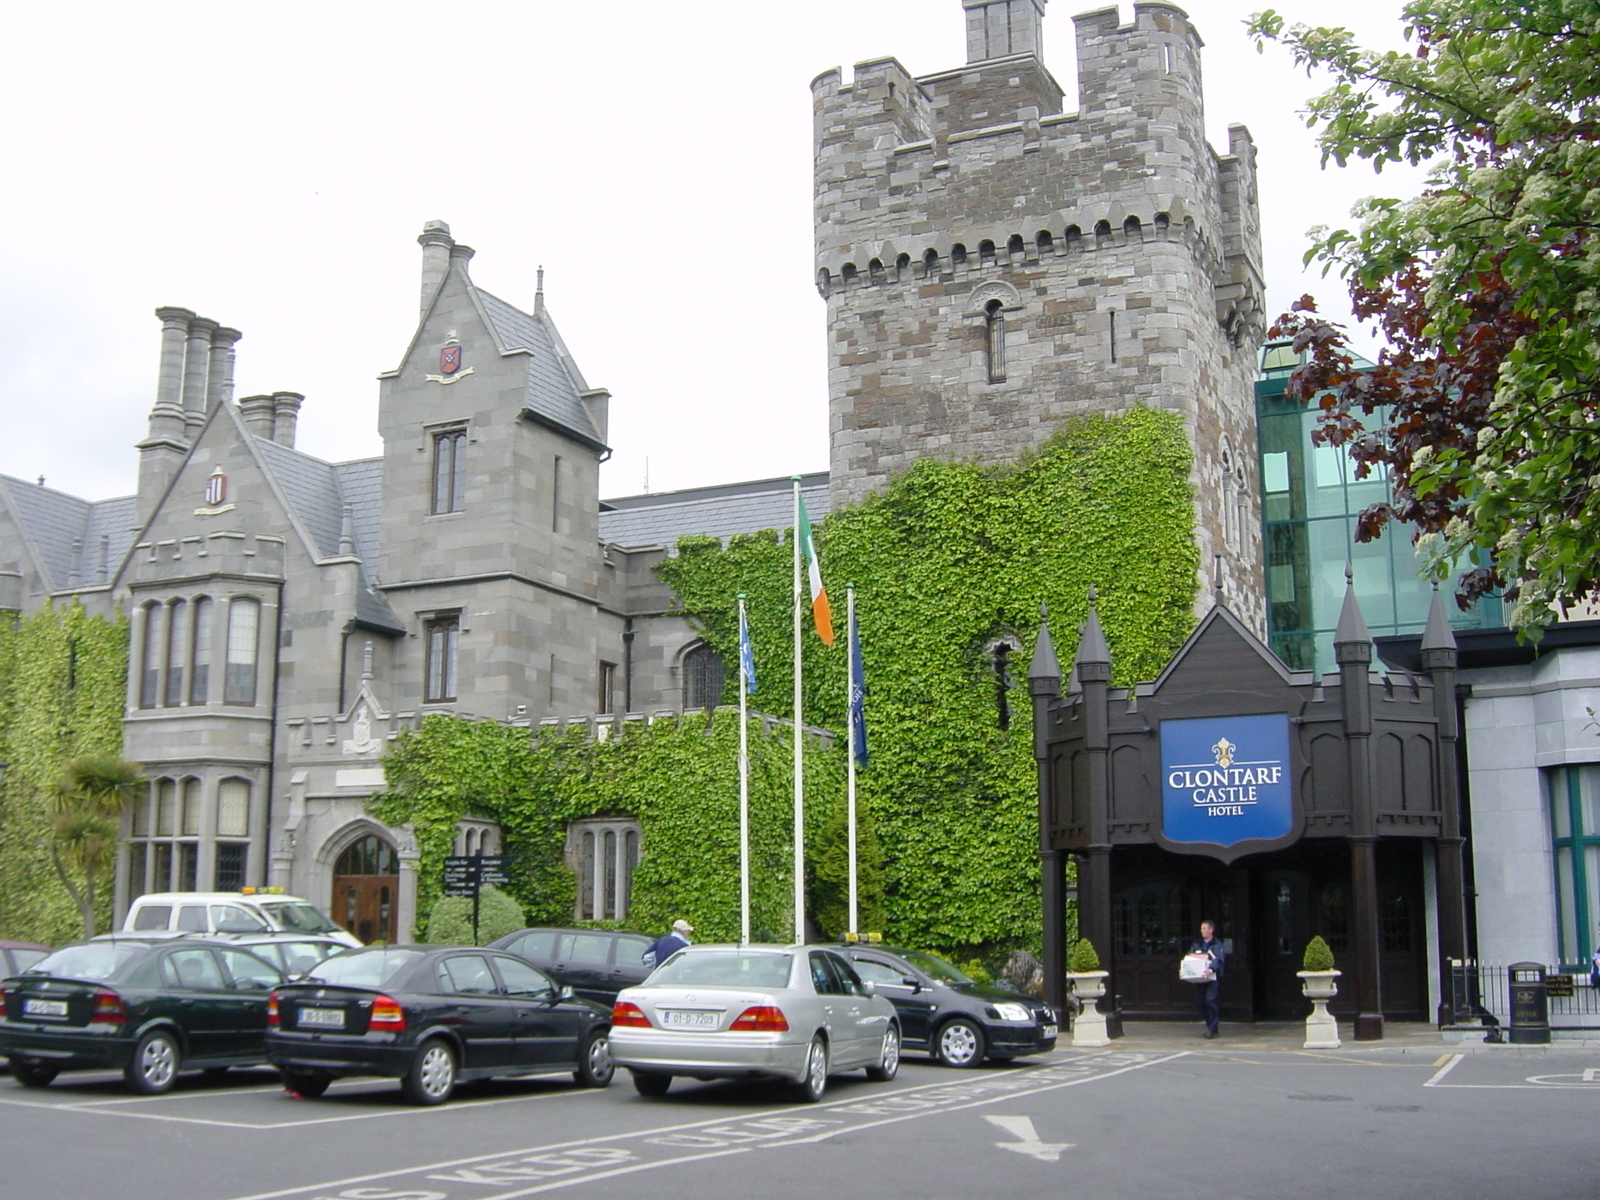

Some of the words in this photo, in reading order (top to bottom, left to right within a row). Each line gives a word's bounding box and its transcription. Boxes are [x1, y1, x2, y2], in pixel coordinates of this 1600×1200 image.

[1168, 767, 1282, 789] CLONTARF
[1192, 786, 1258, 803] CASTLE
[1208, 806, 1244, 816] HOTEL
[673, 1013, 714, 1025] 01-D-7209
[426, 1147, 641, 1186] KEEP
